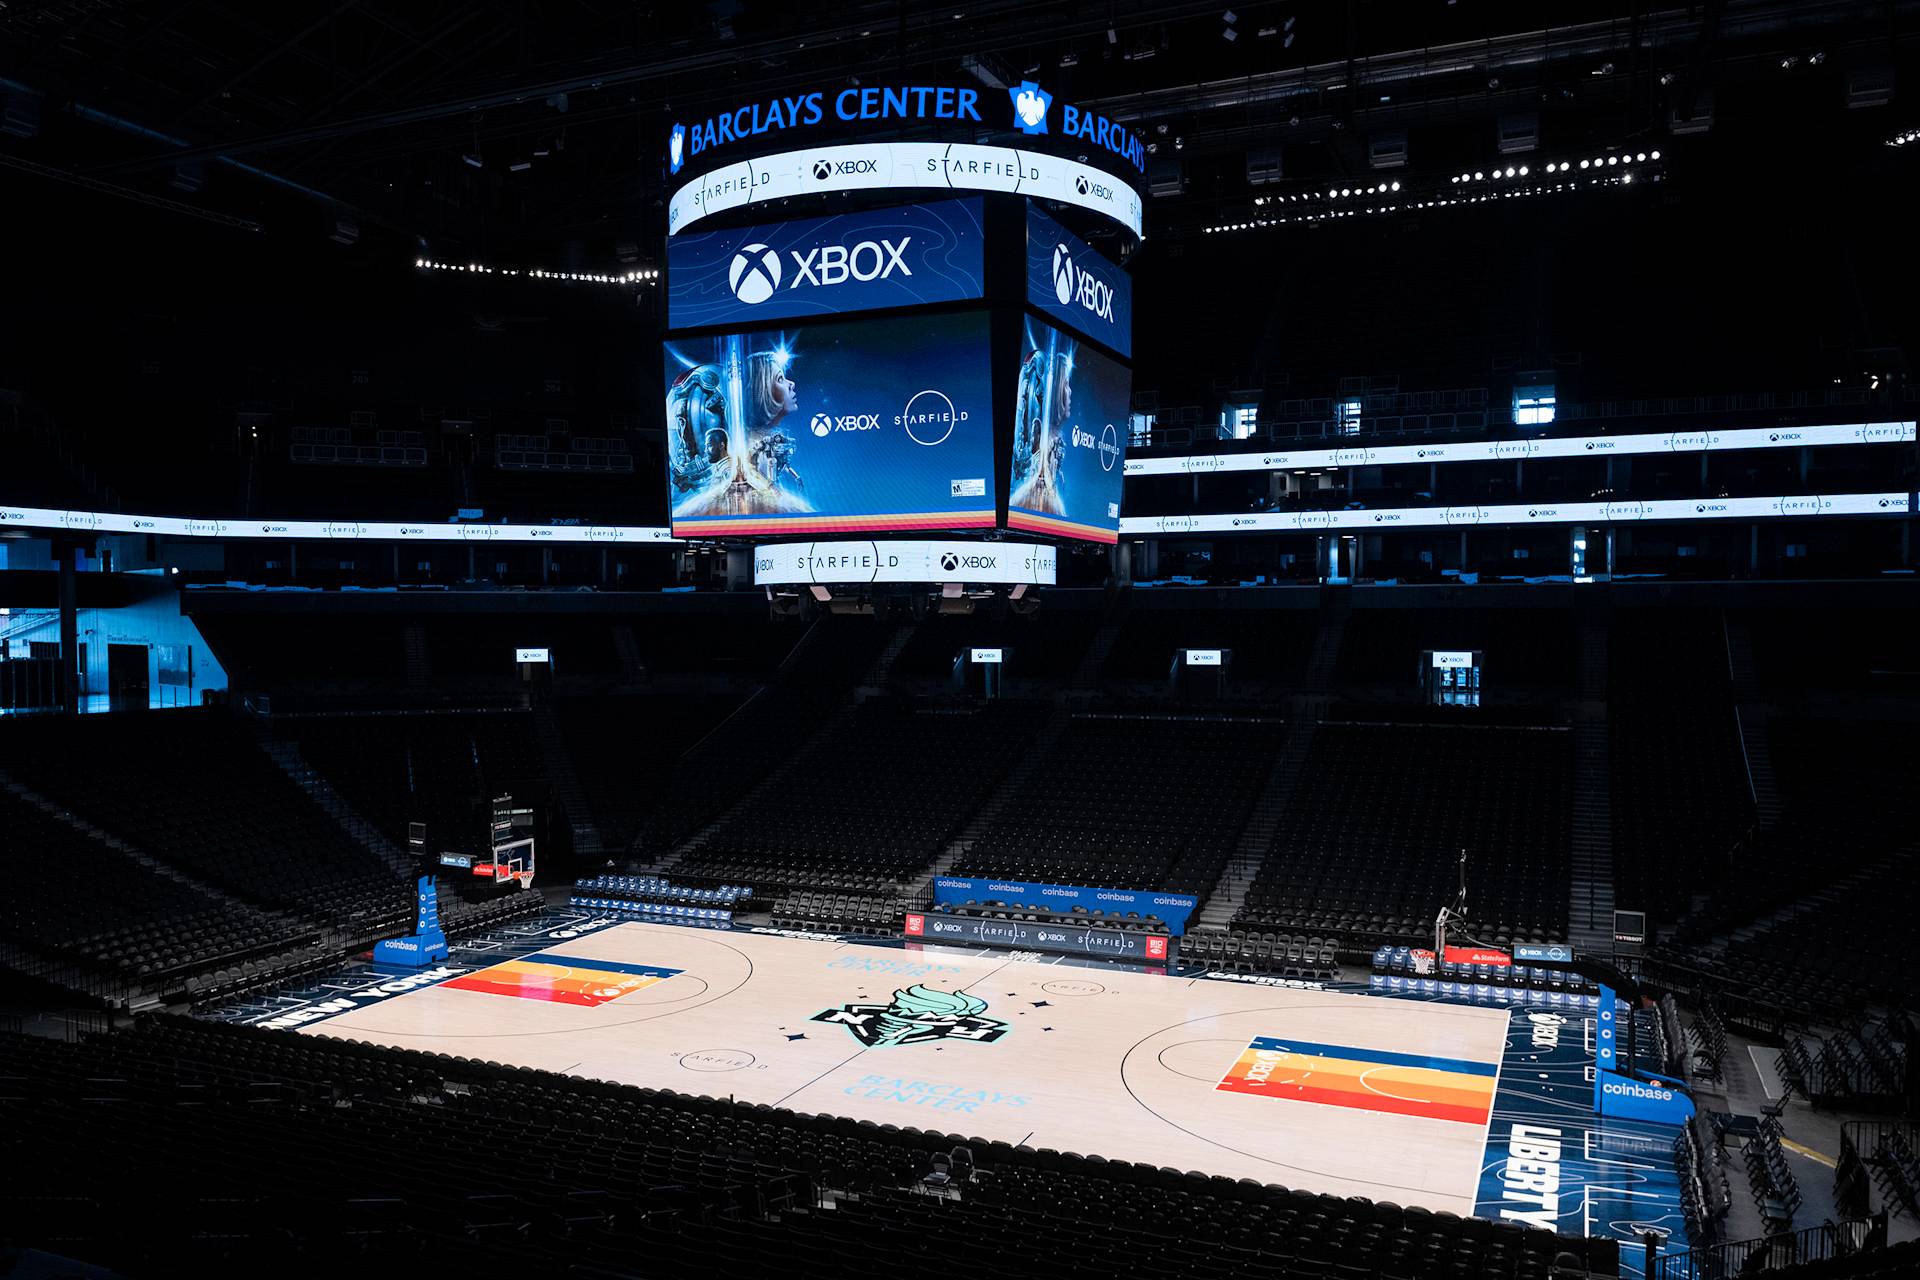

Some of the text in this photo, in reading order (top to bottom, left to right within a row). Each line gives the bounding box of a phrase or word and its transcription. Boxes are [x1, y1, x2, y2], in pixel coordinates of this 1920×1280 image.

[690, 87, 982, 155] BARCLAYS CENTER
[1063, 104, 1145, 174] BARCLAYS
[694, 172, 770, 205] STARFIELD
[834, 159, 877, 176] XBOX
[927, 157, 1039, 180] STARFIELD
[1090, 182, 1114, 203] XBOX
[790, 236, 912, 290] XBOX
[1075, 263, 1114, 323] XBOX
[834, 411, 969, 433] XBOX STARFIELD
[1080, 431, 1096, 450] XBOX
[1181, 460, 1225, 468] STARFIELD
[1329, 453, 1376, 461] STARFIELD
[1488, 445, 1539, 454] STARFIELD
[1663, 437, 1719, 446] STARFIELD
[1854, 428, 1916, 437] STARFIELD
[60, 516, 102, 525] STARFIELD
[184, 524, 227, 532] STARFIELD
[1156, 520, 1199, 528] STARFIELD
[1292, 516, 1338, 524] STARFIELD
[1439, 511, 1489, 519] STARFIELD
[1599, 507, 1653, 515] STARFIELD
[1773, 501, 1831, 510] STARFIELD
[798, 556, 899, 569] STARFIELD
[961, 555, 997, 569] XBOX
[937, 879, 1193, 907] coinbase coinbase coinbase coinbase coinbase
[384, 940, 418, 951] coinbase
[943, 924, 1135, 949] XBOX STARFIELD XBOX STARFIELD
[350, 966, 468, 997] YORK
[1531, 1022, 1559, 1048] XBOX
[1242, 1059, 1278, 1083] XBOX
[843, 1087, 987, 1115] CENTER
[857, 1074, 1033, 1108] BARCLAYS
[1602, 1083, 1673, 1102] coinbase
[1500, 1123, 1562, 1234] LIBERTY
